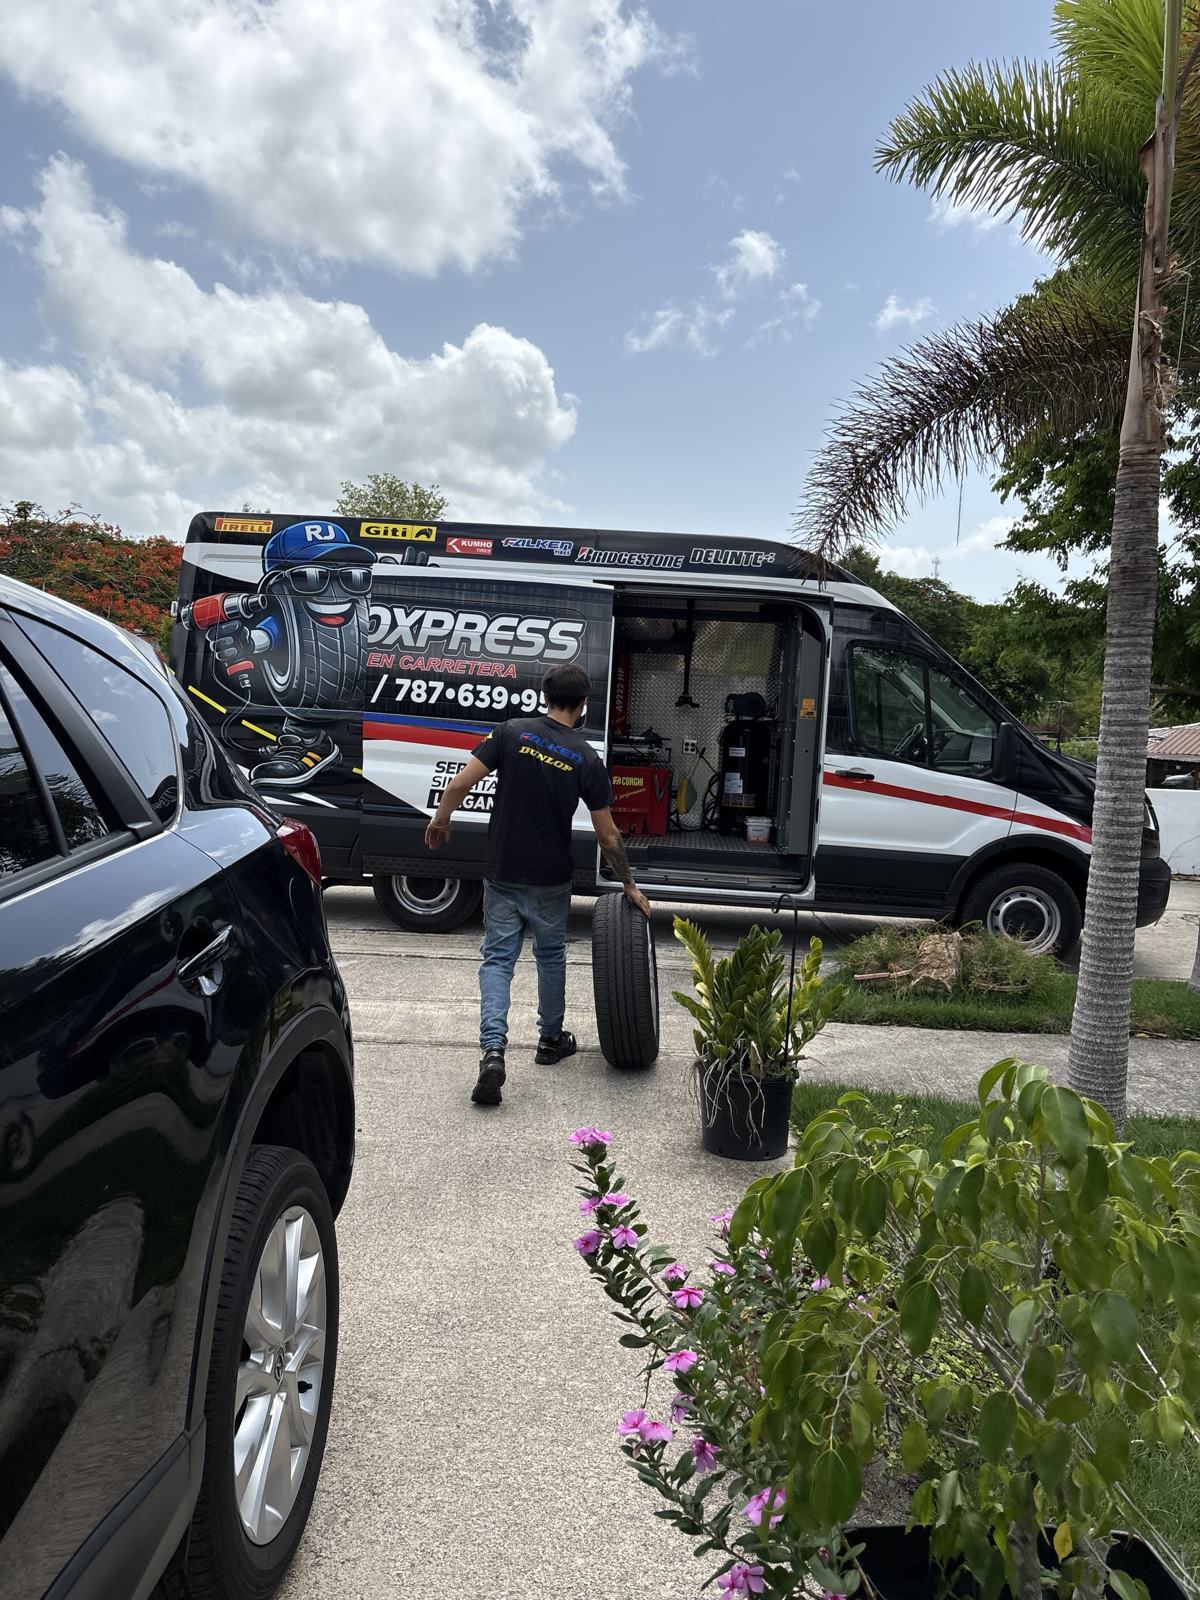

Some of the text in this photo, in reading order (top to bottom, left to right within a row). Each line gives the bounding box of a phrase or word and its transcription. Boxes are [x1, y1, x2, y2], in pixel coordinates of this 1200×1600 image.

[216, 518, 272, 533] PIRELLI
[365, 525, 408, 538] Giti
[304, 524, 336, 542] RJ
[461, 540, 494, 549] KUMHO
[501, 537, 574, 551] FALKEN
[554, 549, 571, 557] TIRES
[575, 546, 685, 569] BRIDGESTONE
[367, 653, 517, 678] EN CARRETERA
[519, 746, 574, 772] DUNLOP
[621, 776, 644, 787] CORGHI
